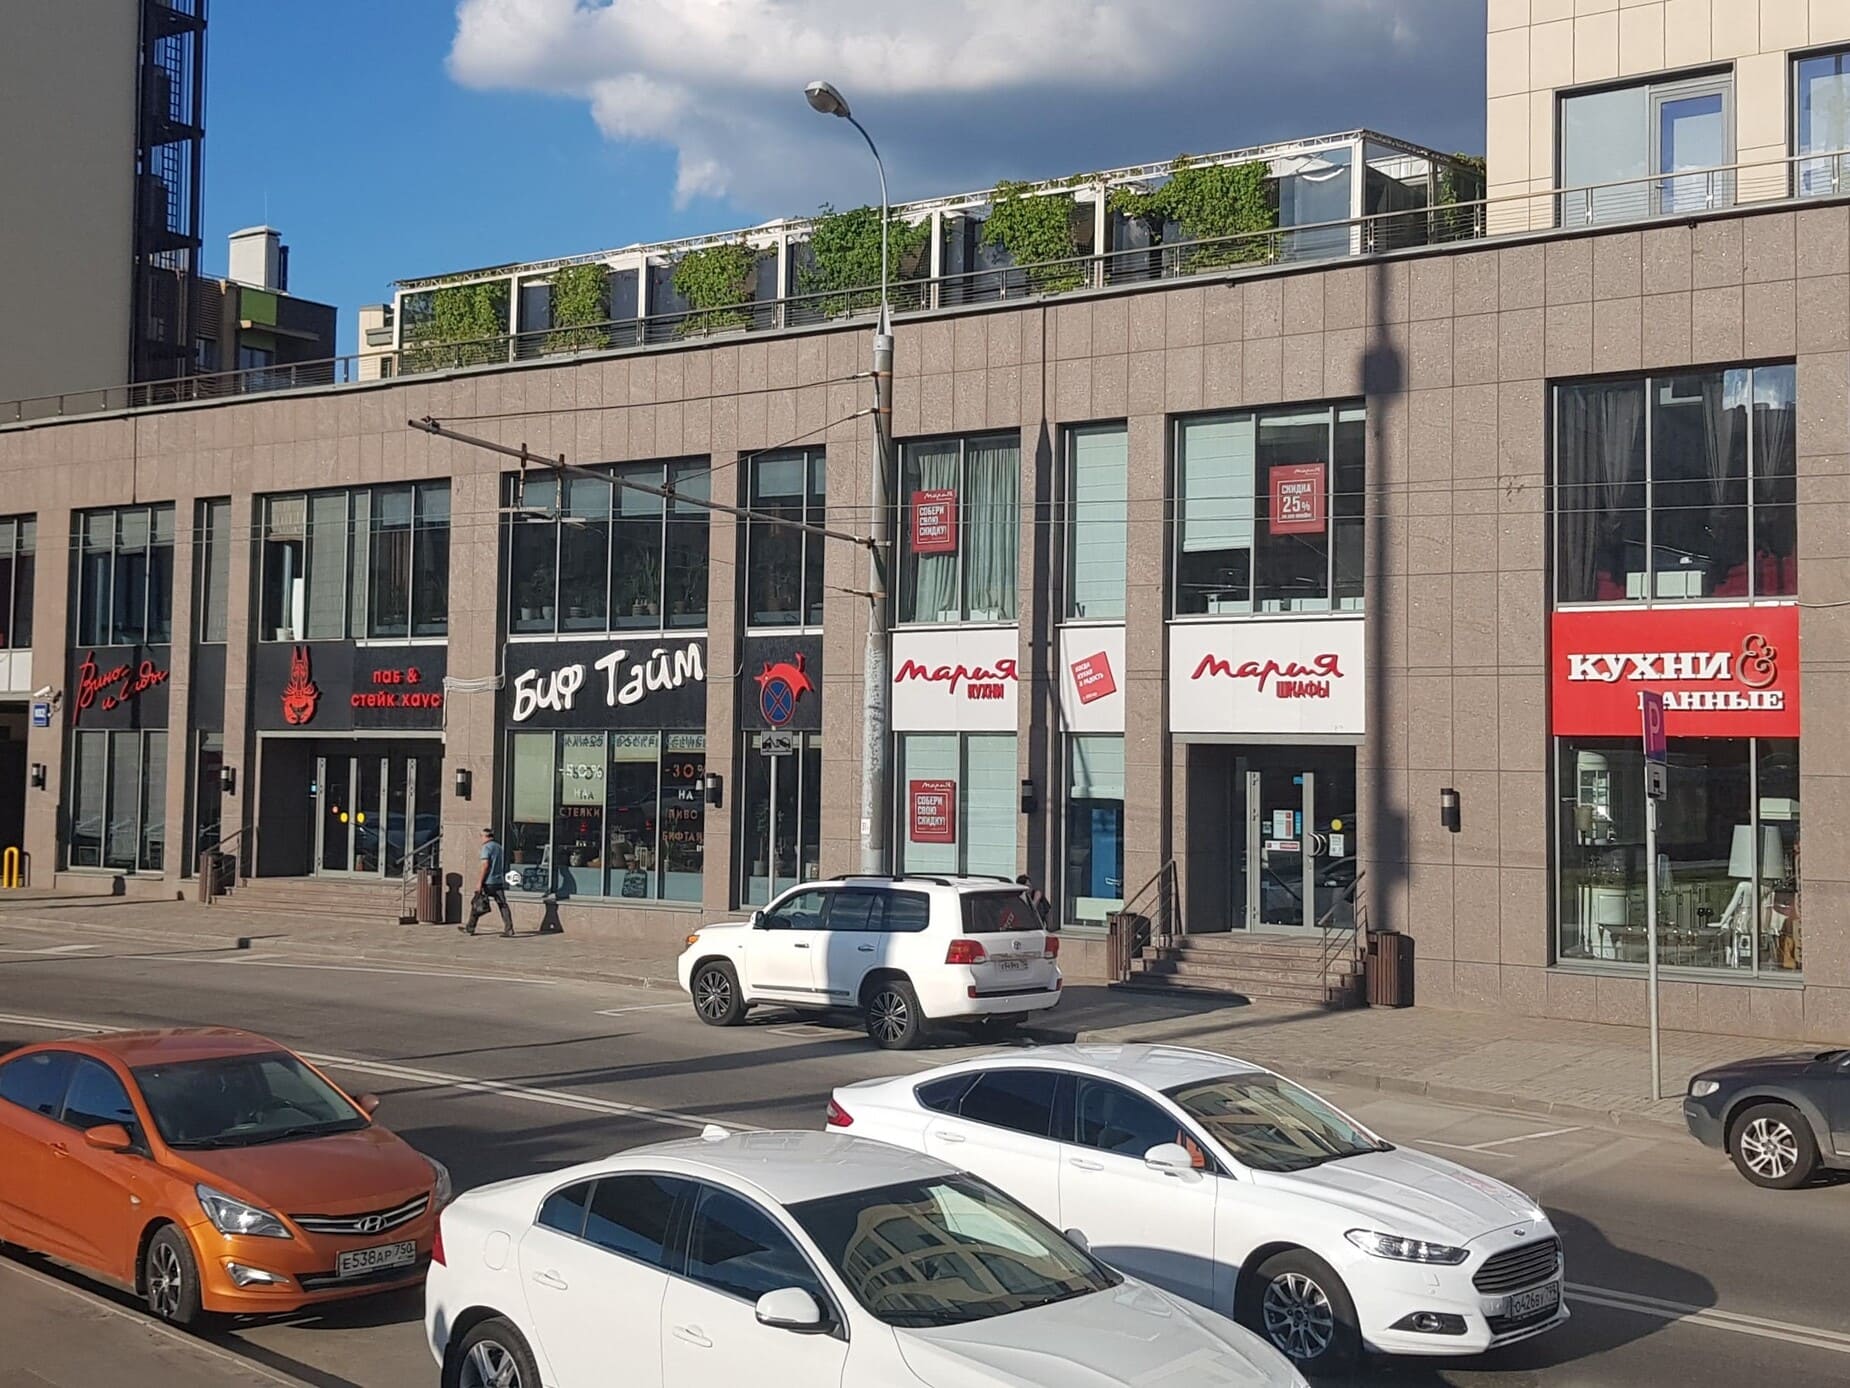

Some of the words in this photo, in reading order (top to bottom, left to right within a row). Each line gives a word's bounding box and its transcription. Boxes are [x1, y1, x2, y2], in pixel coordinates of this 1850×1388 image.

[1281, 483, 1312, 495] СКИДКА
[919, 505, 945, 516] СОБЕРИ
[594, 643, 704, 706] Тайм
[1567, 652, 1732, 682] КУХНИ
[1276, 680, 1330, 698] ШКАФЫ
[678, 788, 695, 801] НА
